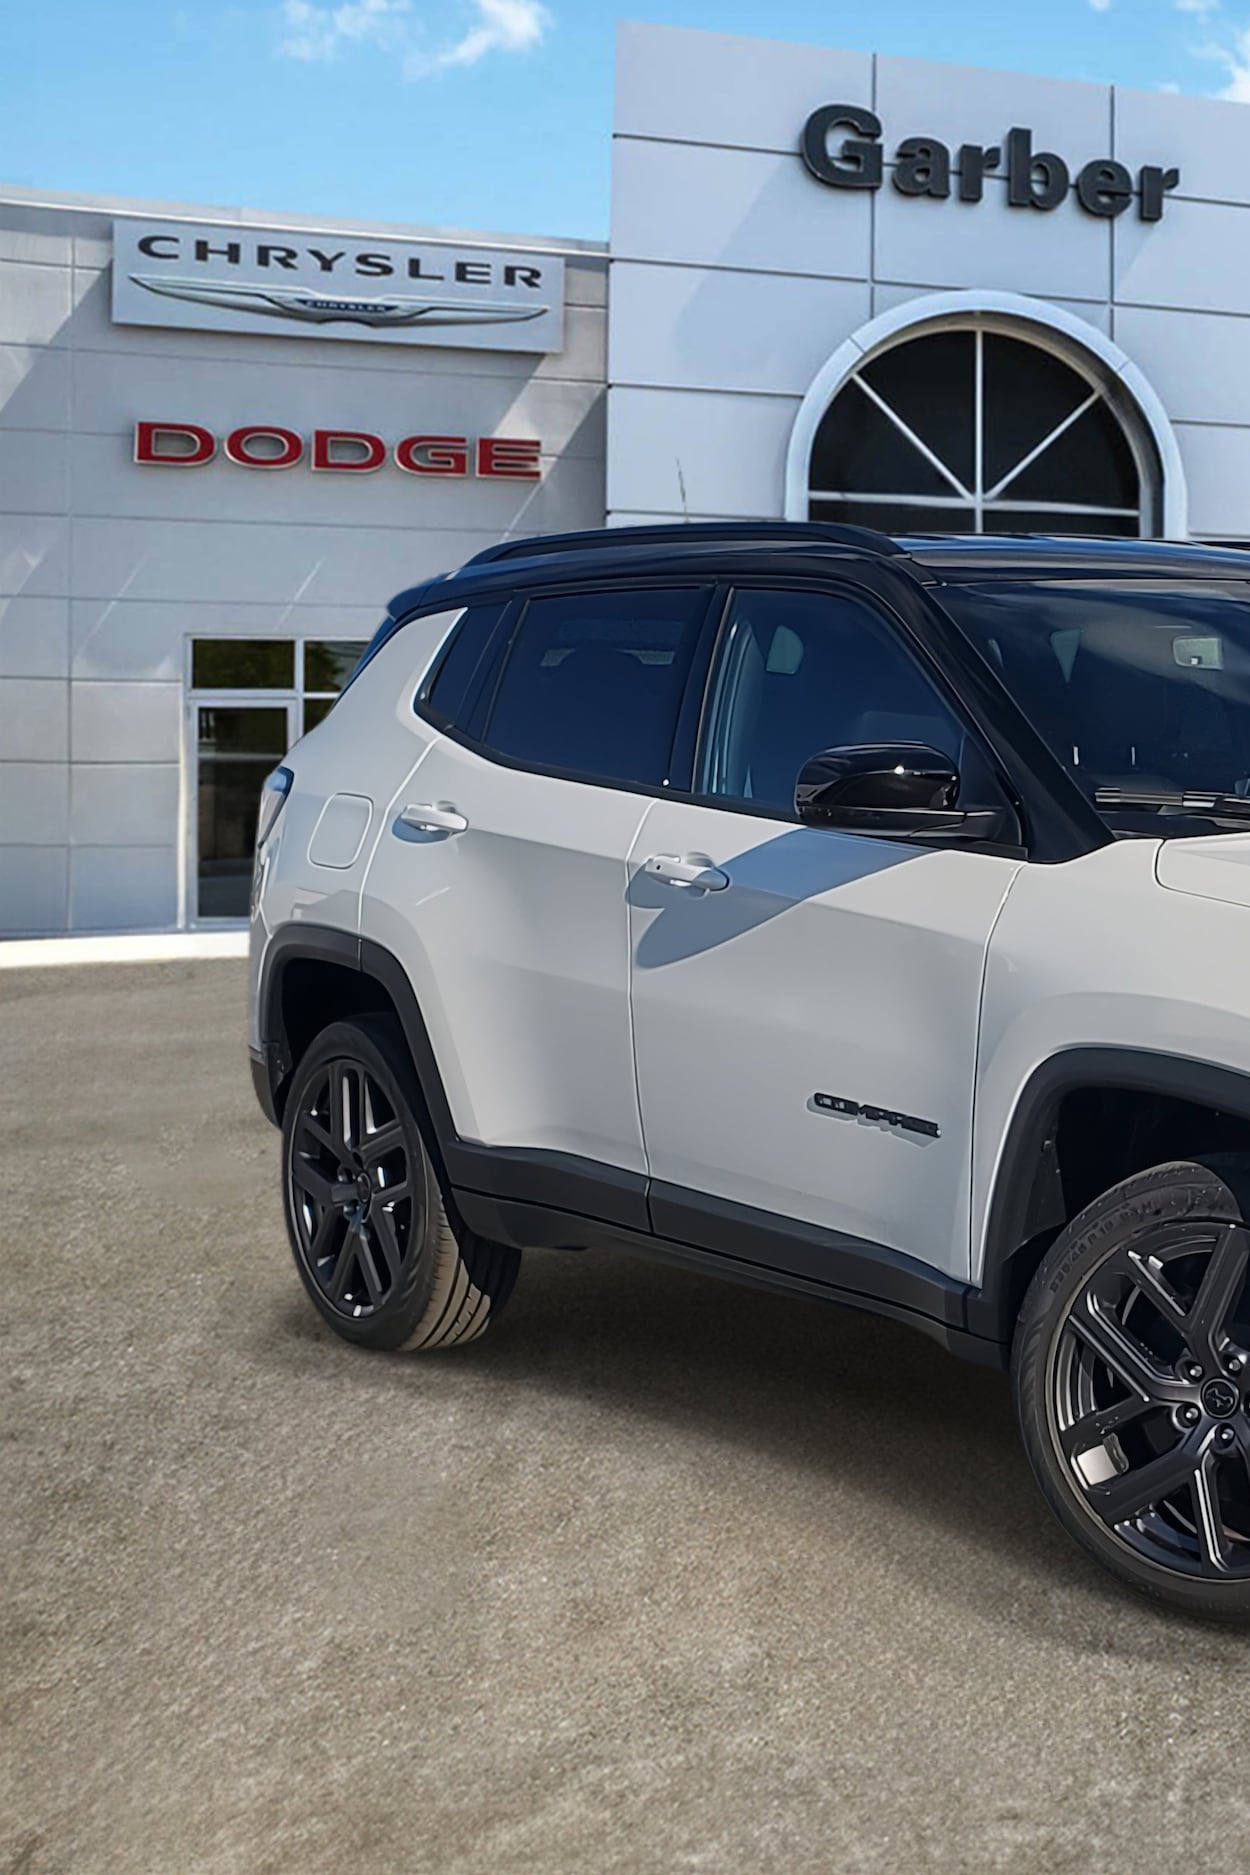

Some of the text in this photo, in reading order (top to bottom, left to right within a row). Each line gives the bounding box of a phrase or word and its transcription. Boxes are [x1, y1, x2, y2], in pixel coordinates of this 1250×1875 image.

[801, 104, 1180, 222] Garber
[137, 235, 543, 288] CHRYSLER
[134, 421, 542, 480] DODGE
